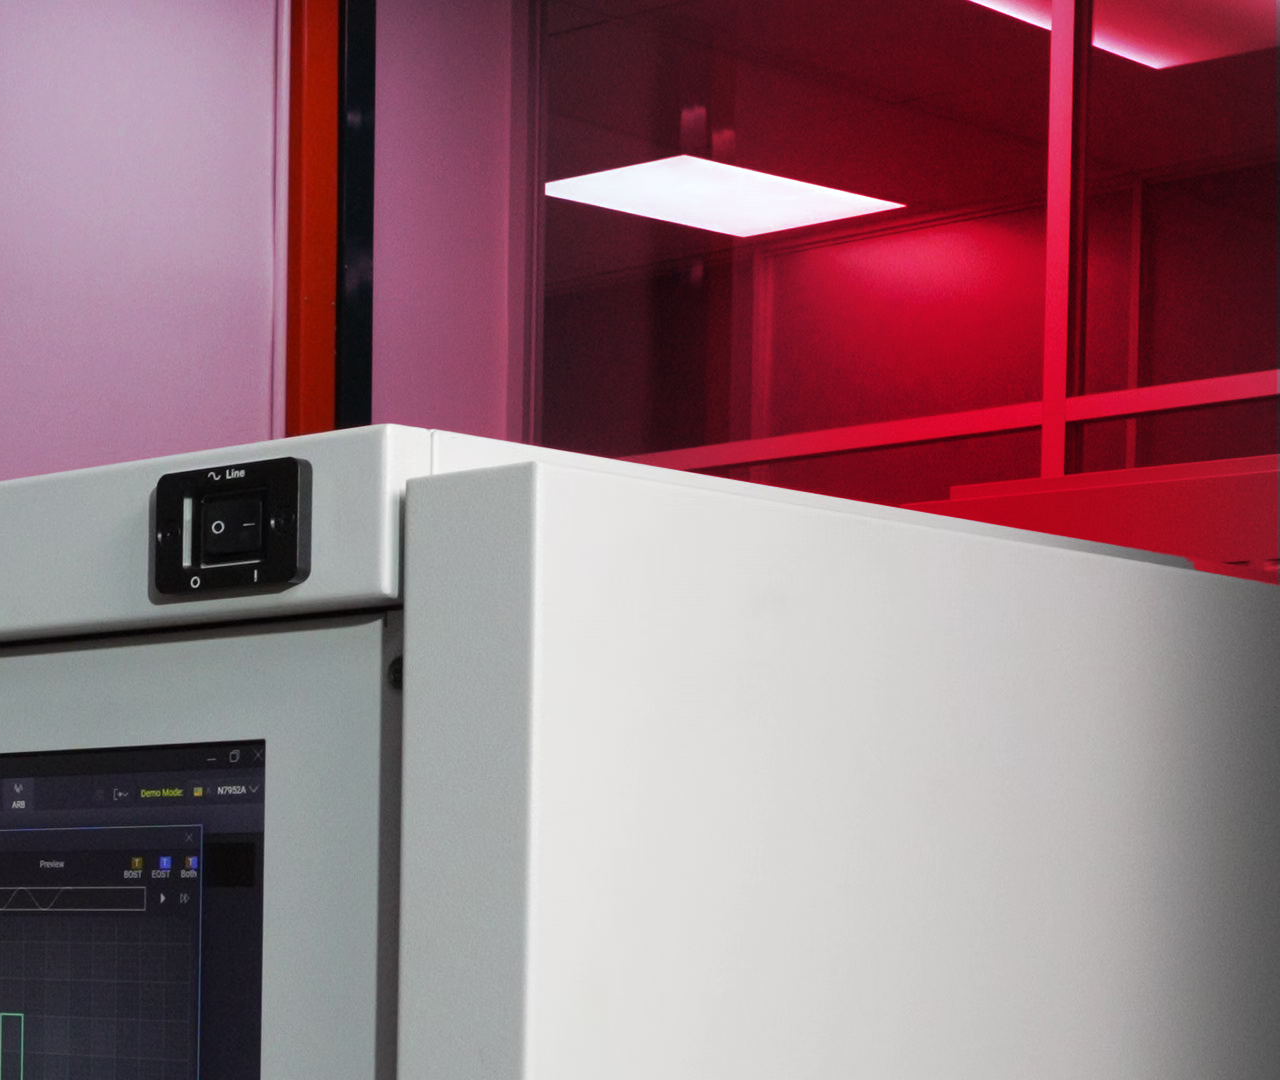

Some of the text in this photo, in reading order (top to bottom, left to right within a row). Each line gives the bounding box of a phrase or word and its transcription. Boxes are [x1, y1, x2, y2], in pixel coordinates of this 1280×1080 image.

[226, 469, 246, 479] Line
[141, 789, 161, 798] Demo
[217, 786, 246, 795] N7952A
[12, 800, 26, 809] ARB
[40, 860, 64, 868] Preview
[181, 870, 198, 878] Both
